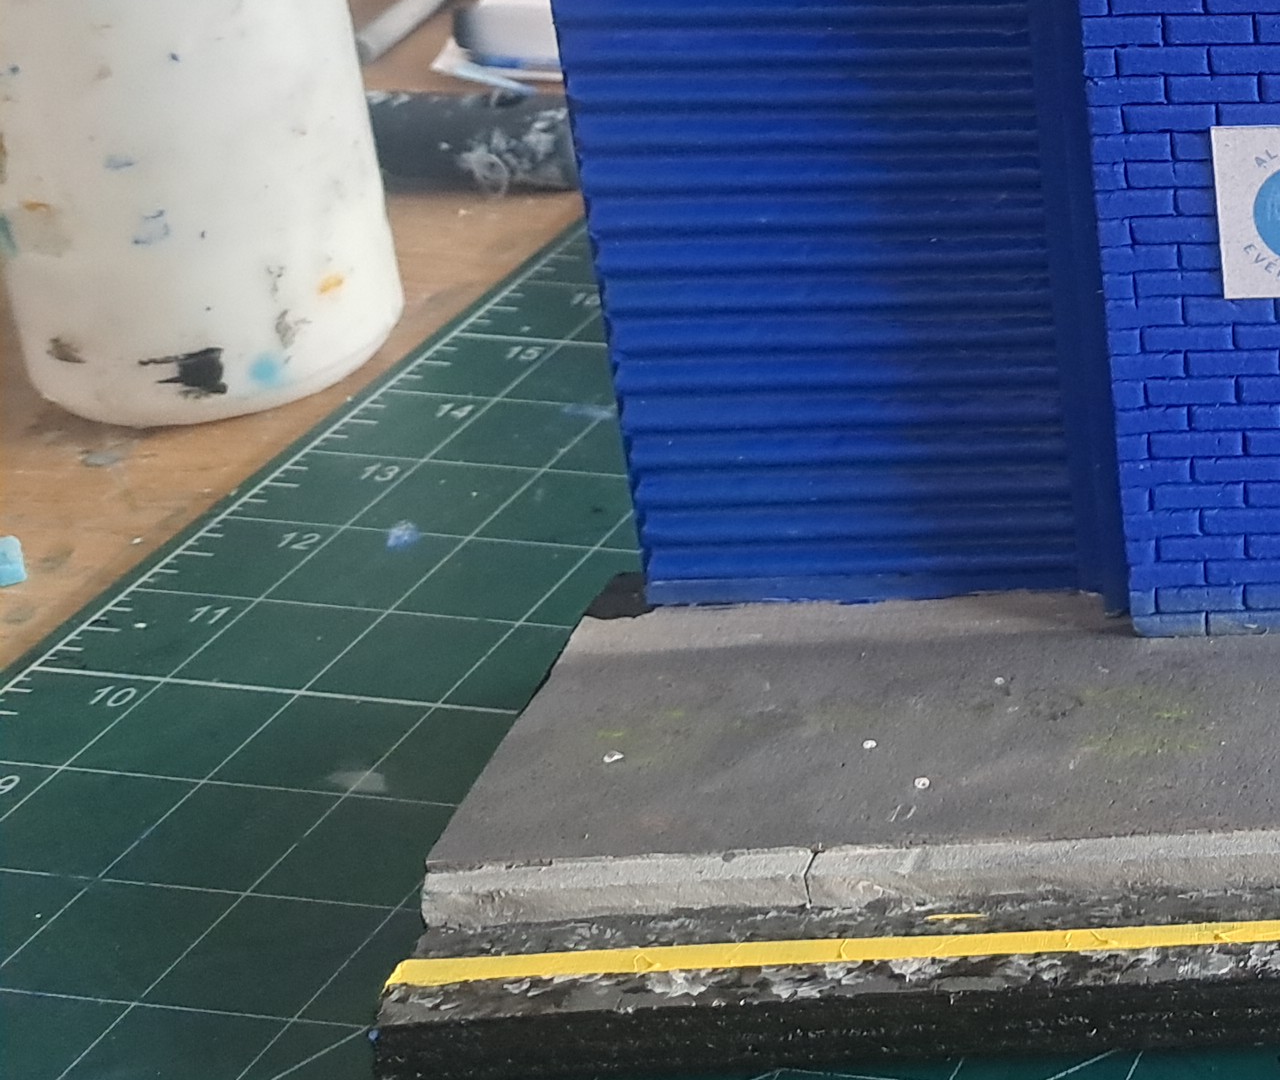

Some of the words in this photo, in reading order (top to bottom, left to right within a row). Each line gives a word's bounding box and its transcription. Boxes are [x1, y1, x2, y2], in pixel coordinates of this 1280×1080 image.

[505, 345, 545, 360] 15
[435, 403, 475, 419] 14
[360, 462, 401, 481] 13
[277, 532, 321, 550] 12
[188, 604, 232, 625] 11
[88, 685, 138, 707] 10
